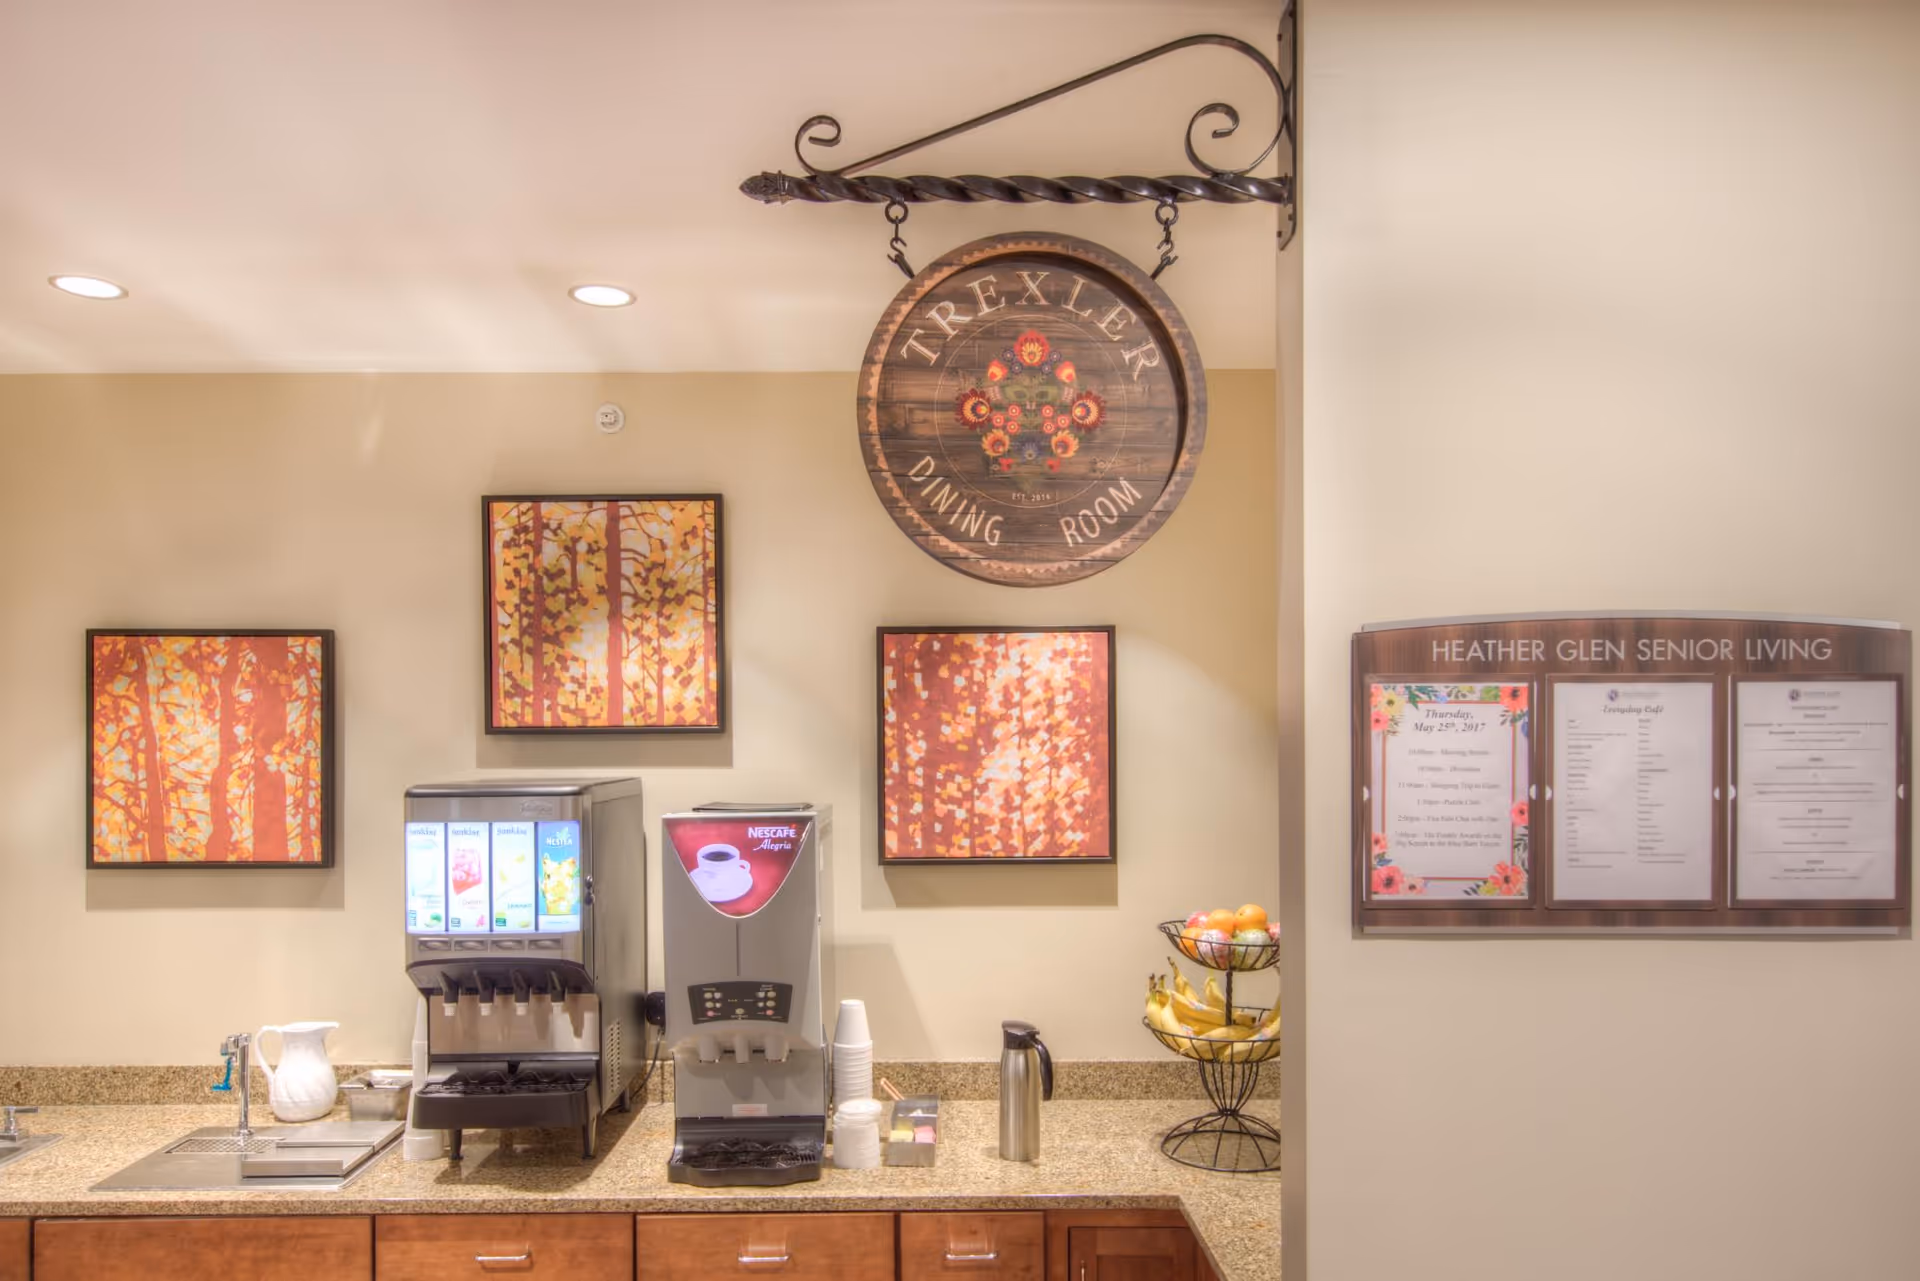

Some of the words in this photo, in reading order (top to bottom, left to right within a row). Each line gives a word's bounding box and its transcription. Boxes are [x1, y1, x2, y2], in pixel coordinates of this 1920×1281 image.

[900, 271, 1162, 381] TREXLER
[907, 455, 1005, 547] DINING
[1058, 476, 1143, 548] ROOM
[1431, 639, 1545, 662] HEATHER
[1556, 639, 1625, 662] GLEN
[1636, 638, 1735, 661] SENIOR
[1745, 638, 1833, 661] LIVING
[1424, 708, 1474, 721] Thursday,
[1413, 721, 1436, 734] May
[1460, 722, 1487, 733] 2017
[545, 837, 573, 846] NESTEA
[753, 839, 793, 851] Alegria
